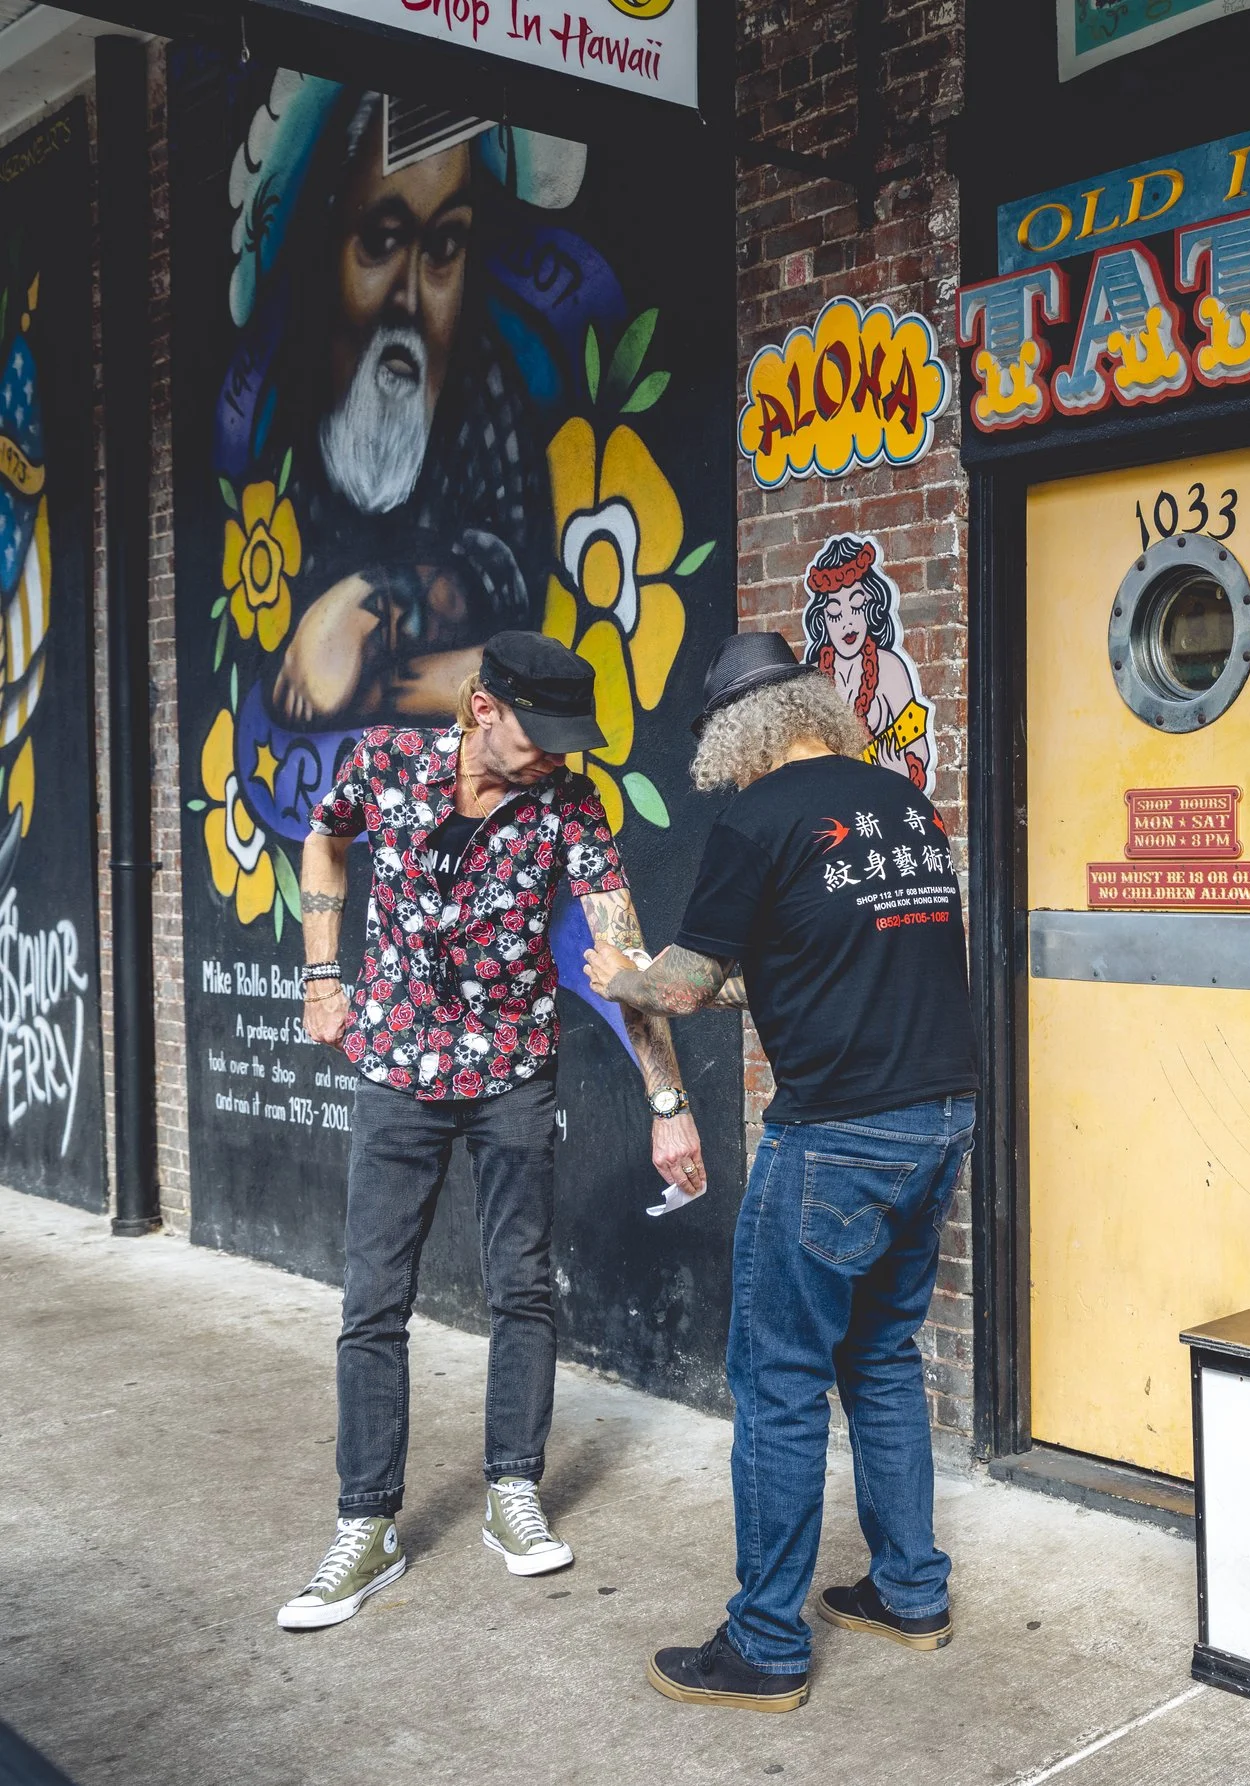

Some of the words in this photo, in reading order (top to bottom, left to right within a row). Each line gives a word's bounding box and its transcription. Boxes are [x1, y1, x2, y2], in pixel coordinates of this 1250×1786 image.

[549, 13, 663, 81] Hawaii
[1017, 168, 1185, 253] OLD
[756, 336, 918, 457] ALOHA
[1135, 482, 1239, 553] 1033
[1137, 799, 1173, 811] SHOP
[1179, 797, 1227, 810] HOURS
[1134, 816, 1174, 830] MON
[1191, 814, 1230, 829] SAT
[1134, 834, 1176, 848] NOON
[1205, 833, 1230, 847] PM
[1090, 872, 1117, 884] YOU
[1120, 871, 1163, 884] MUST
[1166, 871, 1185, 884] BE
[1188, 871, 1204, 884] 18
[1207, 871, 1228, 884] OR
[856, 893, 878, 906] SHOP
[879, 891, 893, 901] 112
[918, 886, 943, 895] NATHAN
[943, 886, 956, 895] ROAD
[874, 901, 897, 912] MONG
[913, 897, 933, 906] HONG
[933, 896, 949, 904] KONG
[1098, 887, 1118, 900] NO
[1122, 887, 1196, 900] CHILDREN
[876, 911, 950, 931] (852)-6705-1087
[202, 960, 232, 995] Mike
[236, 1013, 244, 1037] A
[280, 1016, 290, 1045] of
[209, 1048, 227, 1072] took
[229, 1059, 250, 1076] over
[251, 1055, 265, 1078] the
[271, 1058, 296, 1089] shop
[315, 1064, 331, 1088] and
[216, 1087, 232, 1112] and
[233, 1098, 250, 1115] ran
[252, 1090, 260, 1116] it
